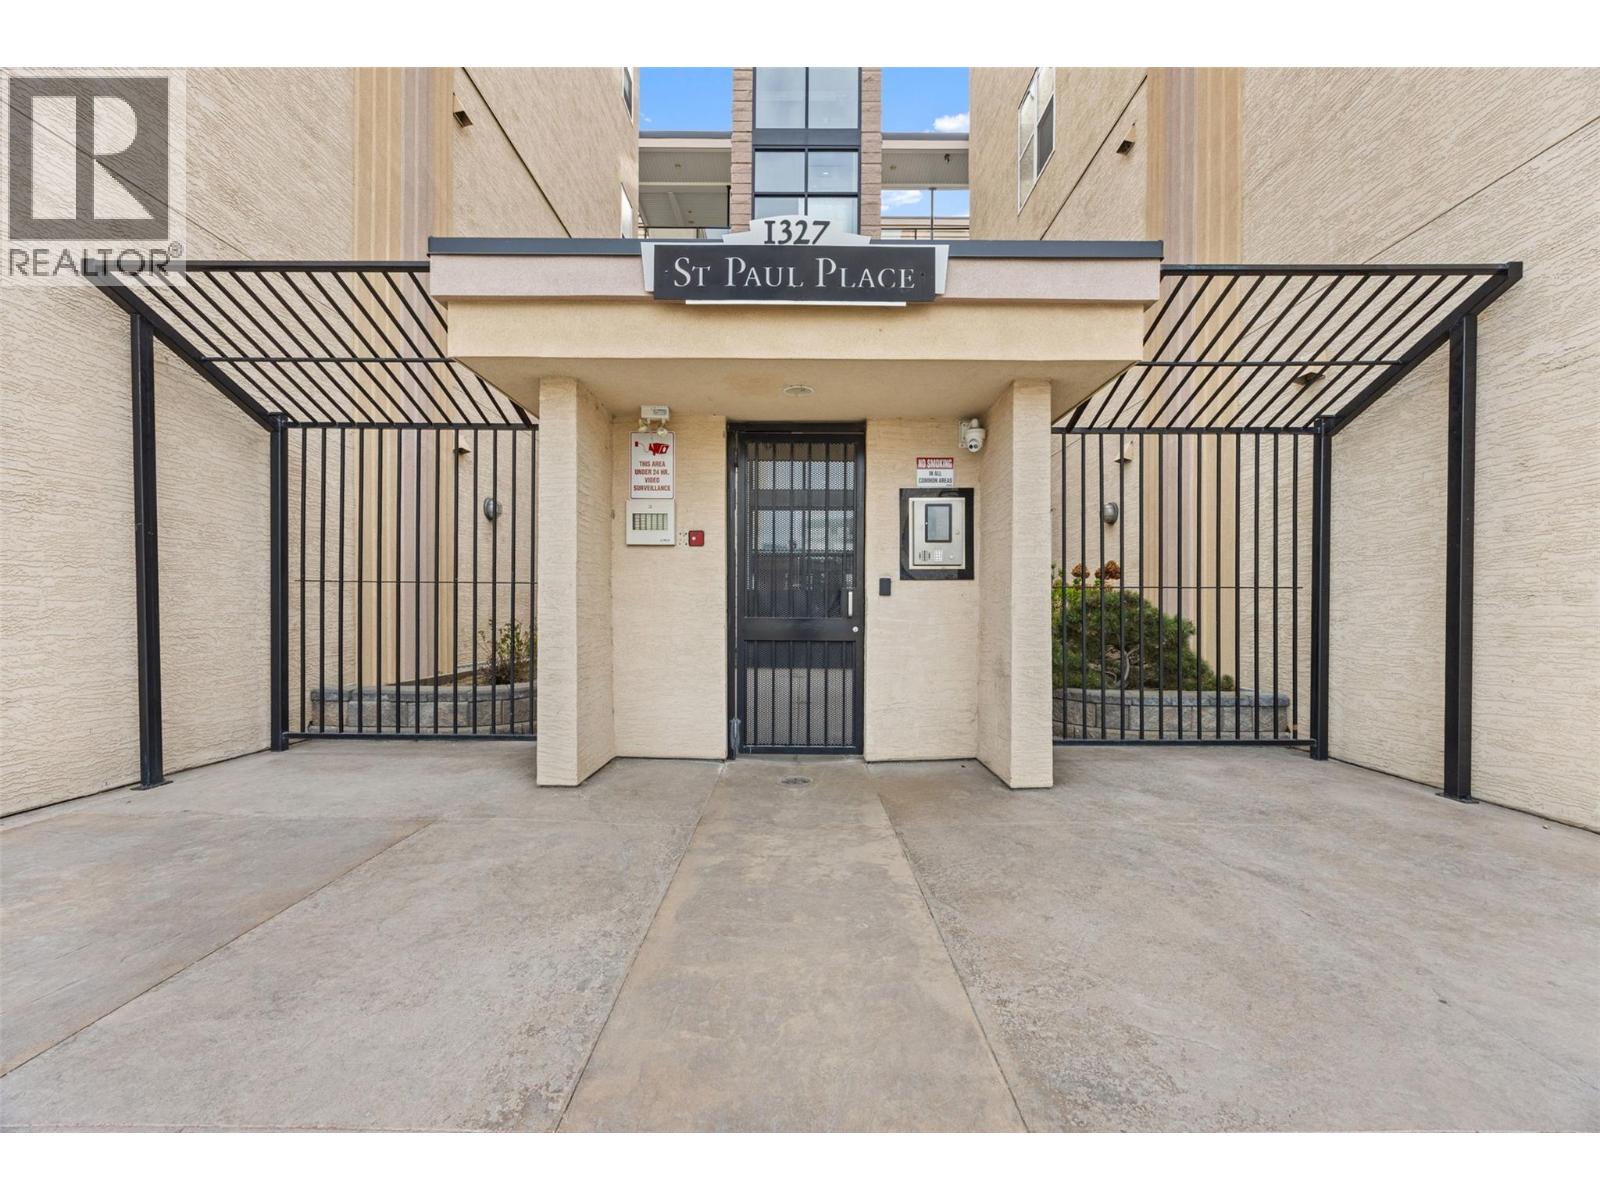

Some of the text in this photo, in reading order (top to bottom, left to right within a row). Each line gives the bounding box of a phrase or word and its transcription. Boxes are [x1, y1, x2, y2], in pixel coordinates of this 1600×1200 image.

[763, 219, 831, 245] 1327
[918, 459, 952, 468] NO SMOKING
